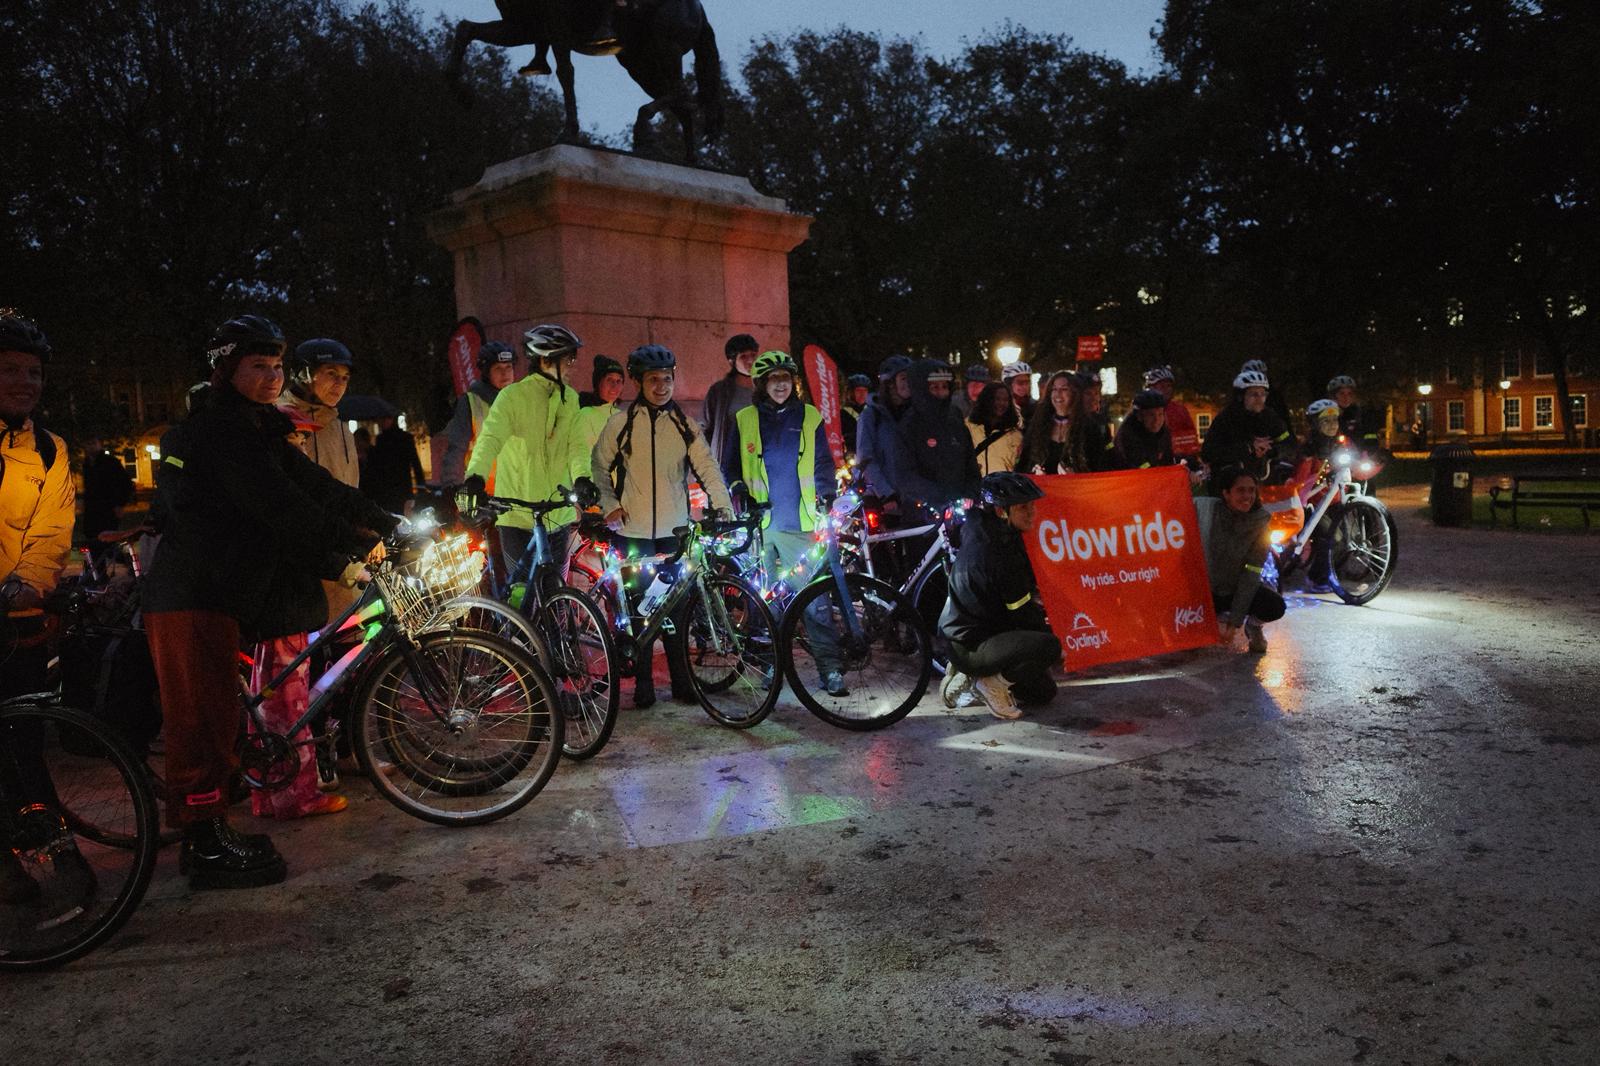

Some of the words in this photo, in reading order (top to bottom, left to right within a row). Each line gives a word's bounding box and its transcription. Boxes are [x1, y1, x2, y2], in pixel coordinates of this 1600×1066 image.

[815, 352, 828, 383] ride
[820, 384, 832, 424] Glow
[1038, 518, 1118, 562] Glow
[1123, 511, 1185, 554] ride
[1080, 573, 1096, 590] My
[1119, 568, 1137, 583] Our
[1137, 566, 1160, 584] right
